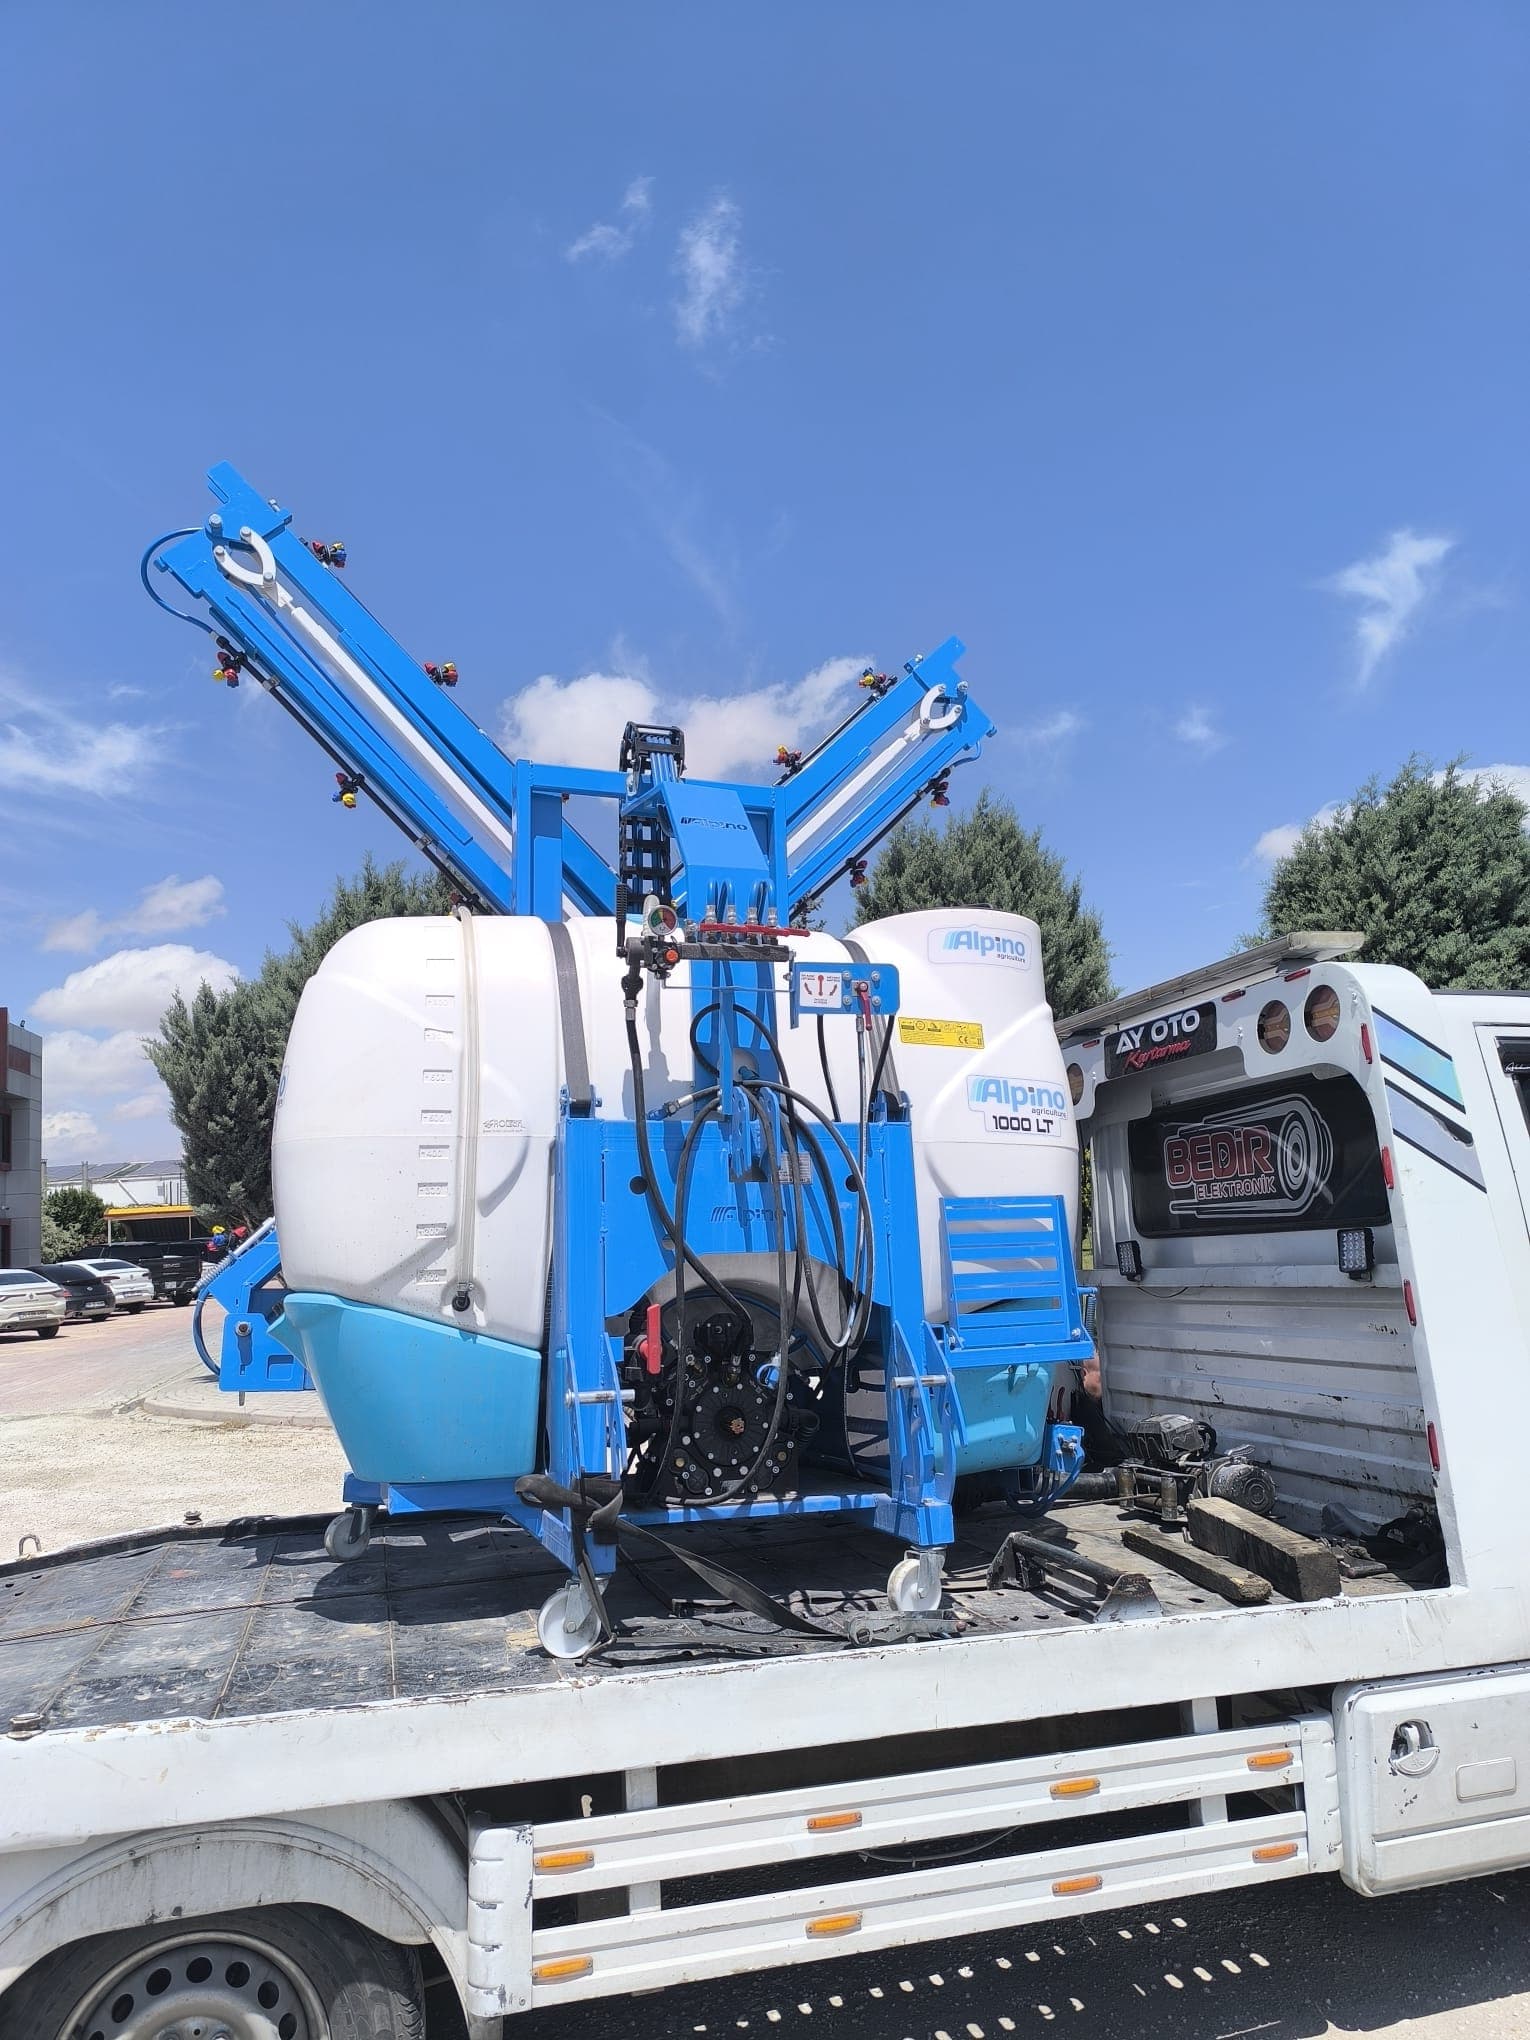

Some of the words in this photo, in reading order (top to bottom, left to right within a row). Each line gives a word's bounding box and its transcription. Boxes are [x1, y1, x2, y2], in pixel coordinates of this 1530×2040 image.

[943, 930, 1026, 957] Alpino
[997, 953, 1026, 963] agriculture
[1116, 1026, 1145, 1055] AY
[1151, 1009, 1200, 1042] OTO
[970, 1079, 1065, 1112] Alpino
[992, 1115, 1032, 1132] 1000
[1036, 1118, 1054, 1133] LT
[1031, 1108, 1067, 1119] agriculture
